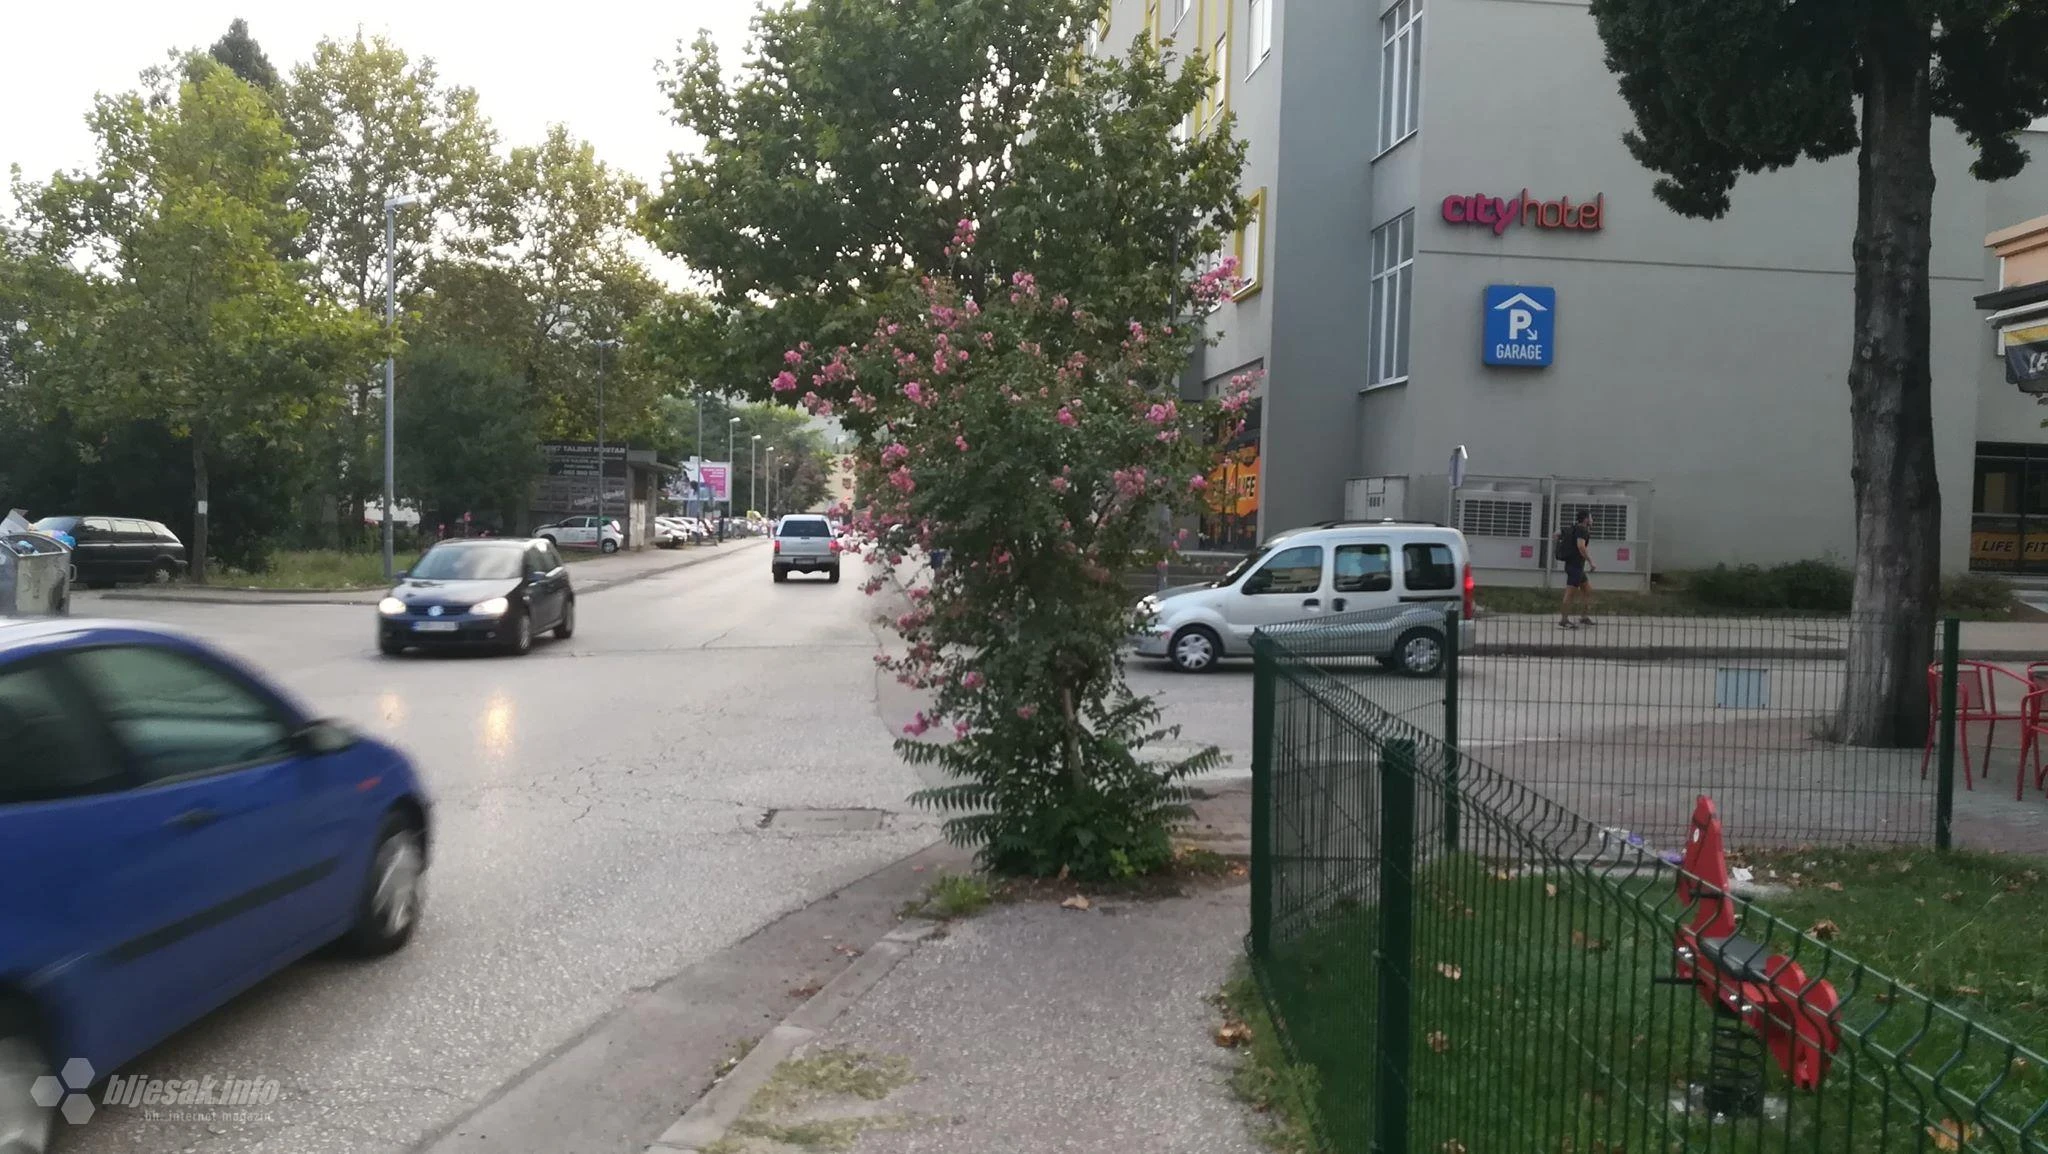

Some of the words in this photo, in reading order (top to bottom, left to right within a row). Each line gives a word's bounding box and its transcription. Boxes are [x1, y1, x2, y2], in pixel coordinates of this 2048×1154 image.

[1509, 309, 1532, 340] P
[1496, 343, 1543, 361] GARAGE
[1981, 540, 2014, 552] LIFE
